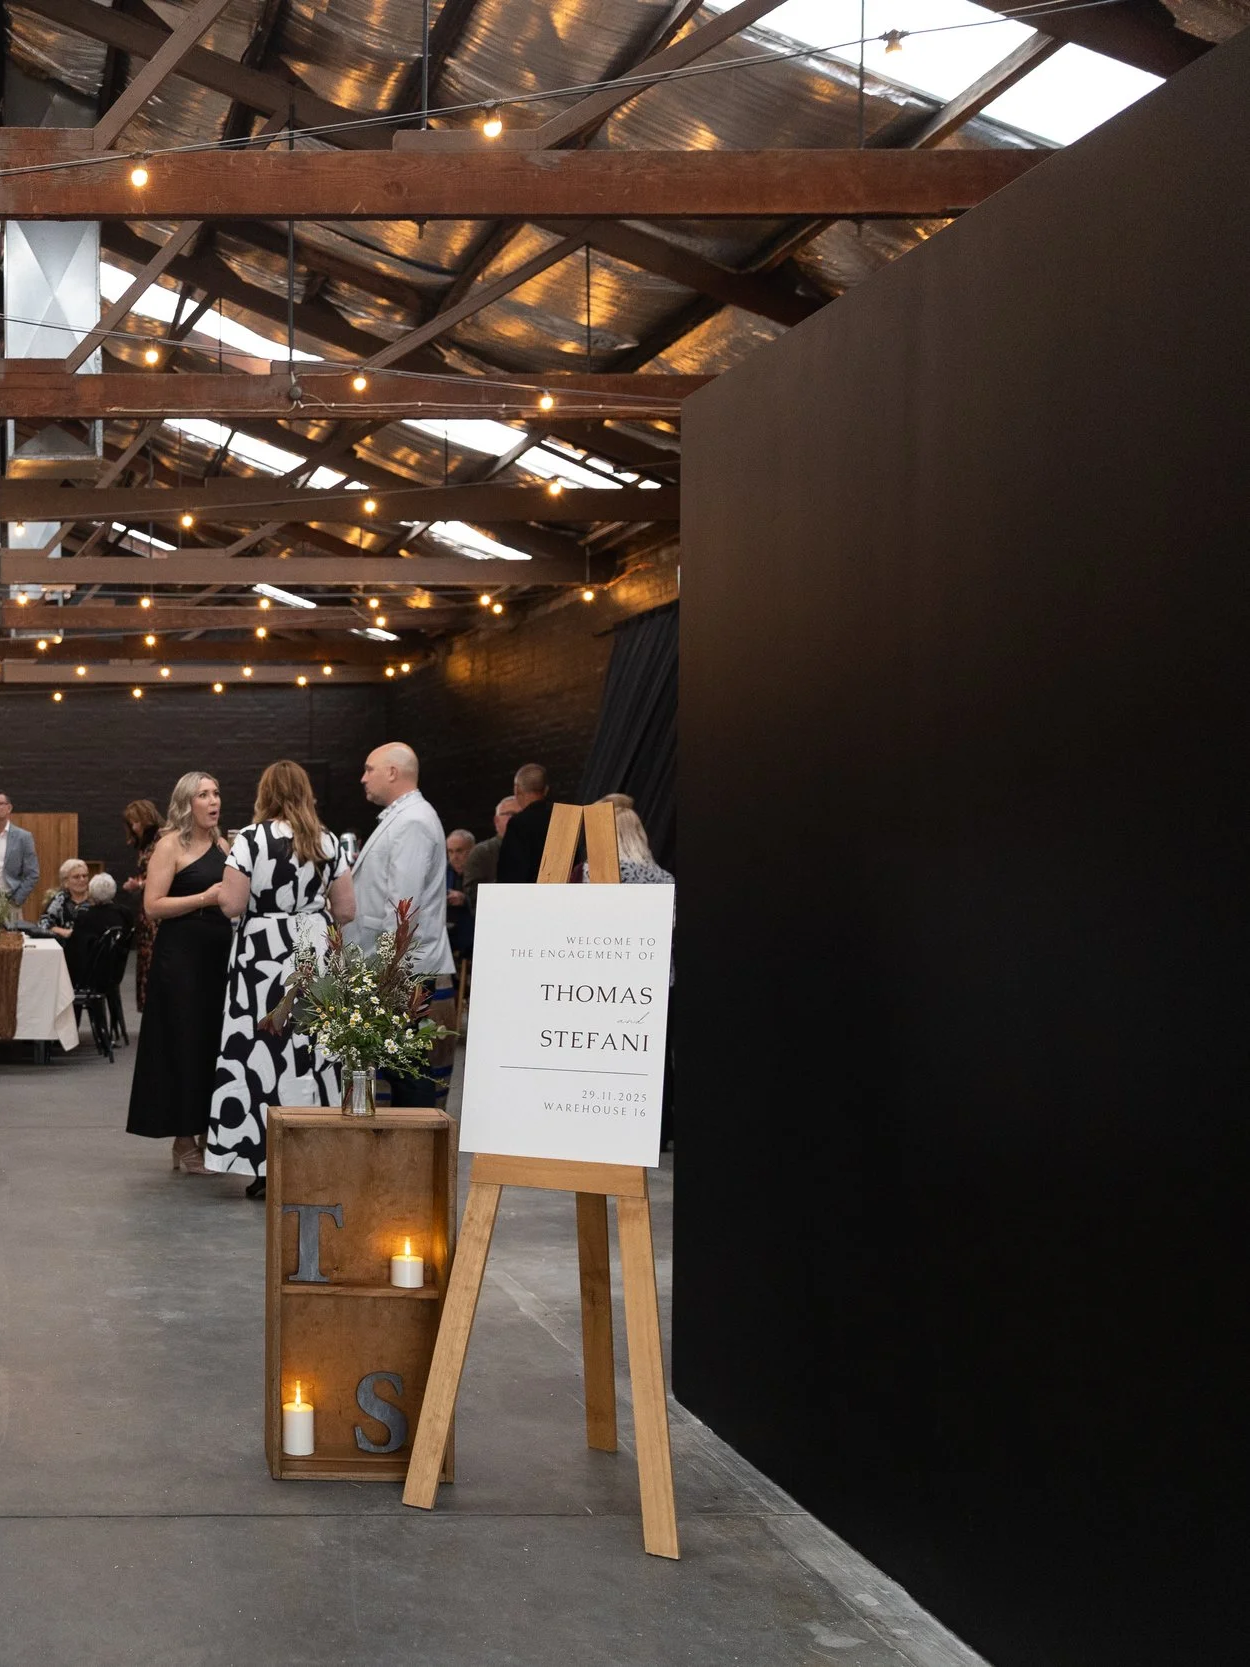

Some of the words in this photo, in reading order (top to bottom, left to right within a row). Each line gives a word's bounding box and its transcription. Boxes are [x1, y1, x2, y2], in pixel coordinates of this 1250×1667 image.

[566, 936, 631, 946] WELCOME
[638, 937, 656, 947] TO
[510, 948, 534, 958] THE
[540, 949, 631, 960] ENGAGEMENT
[638, 951, 655, 961] OF
[541, 984, 653, 1005] THOMAS
[616, 1011, 650, 1025] and
[540, 1030, 649, 1052] STEFANI
[582, 1090, 648, 1102] 29.11.2025
[544, 1102, 627, 1115] WAREHOUSE
[634, 1107, 647, 1117] 16
[282, 1203, 344, 1283] T
[354, 1371, 408, 1454] S
